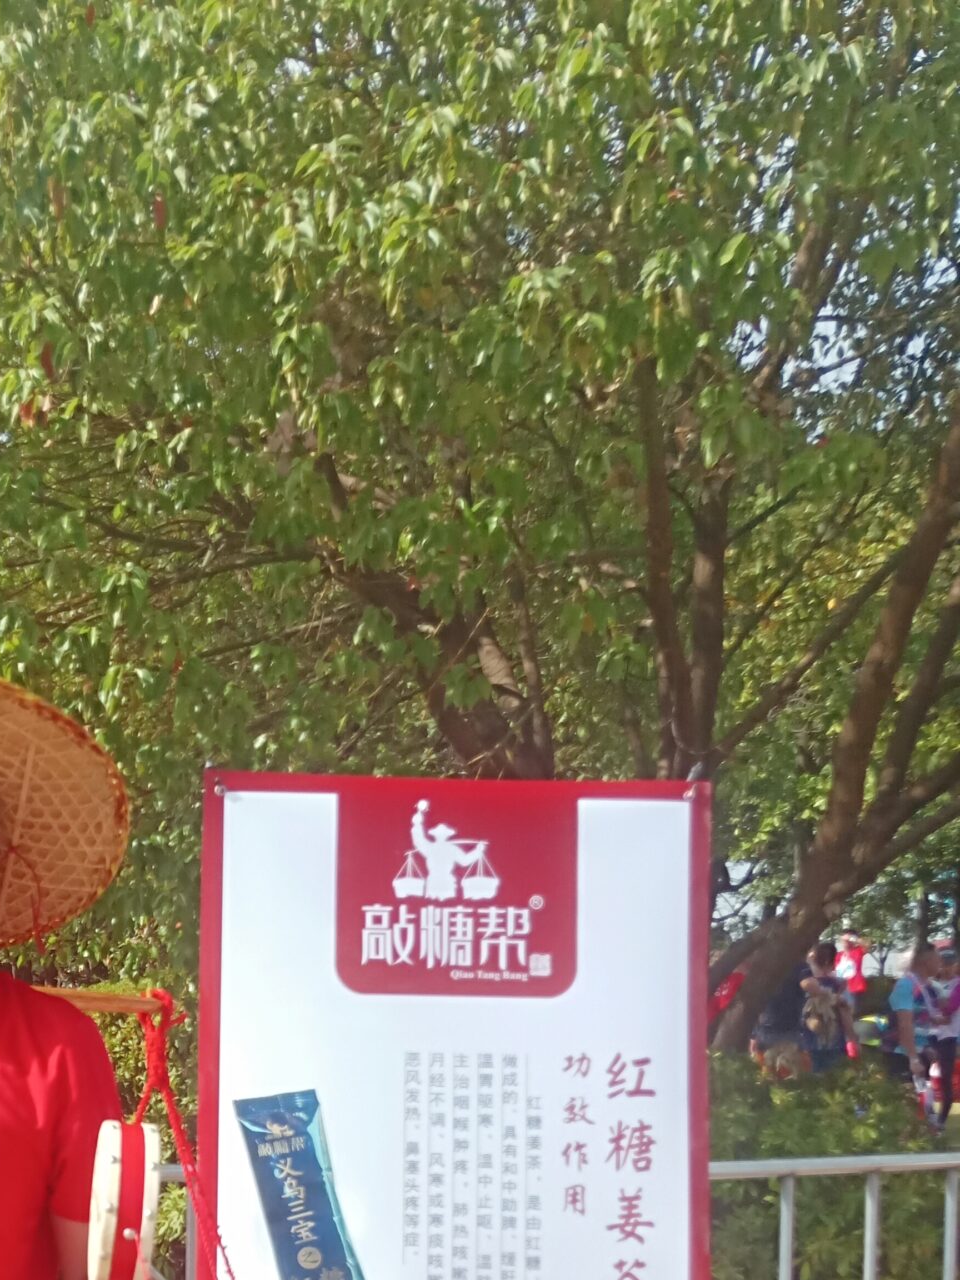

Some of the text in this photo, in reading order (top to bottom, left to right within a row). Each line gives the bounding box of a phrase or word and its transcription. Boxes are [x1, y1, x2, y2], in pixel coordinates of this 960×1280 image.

[361, 904, 531, 971] 敲糖帮
[450, 970, 528, 982] Qiao Tang Bang
[562, 1052, 595, 1216] 功效作用
[274, 1155, 319, 1246] 义乌三宝
